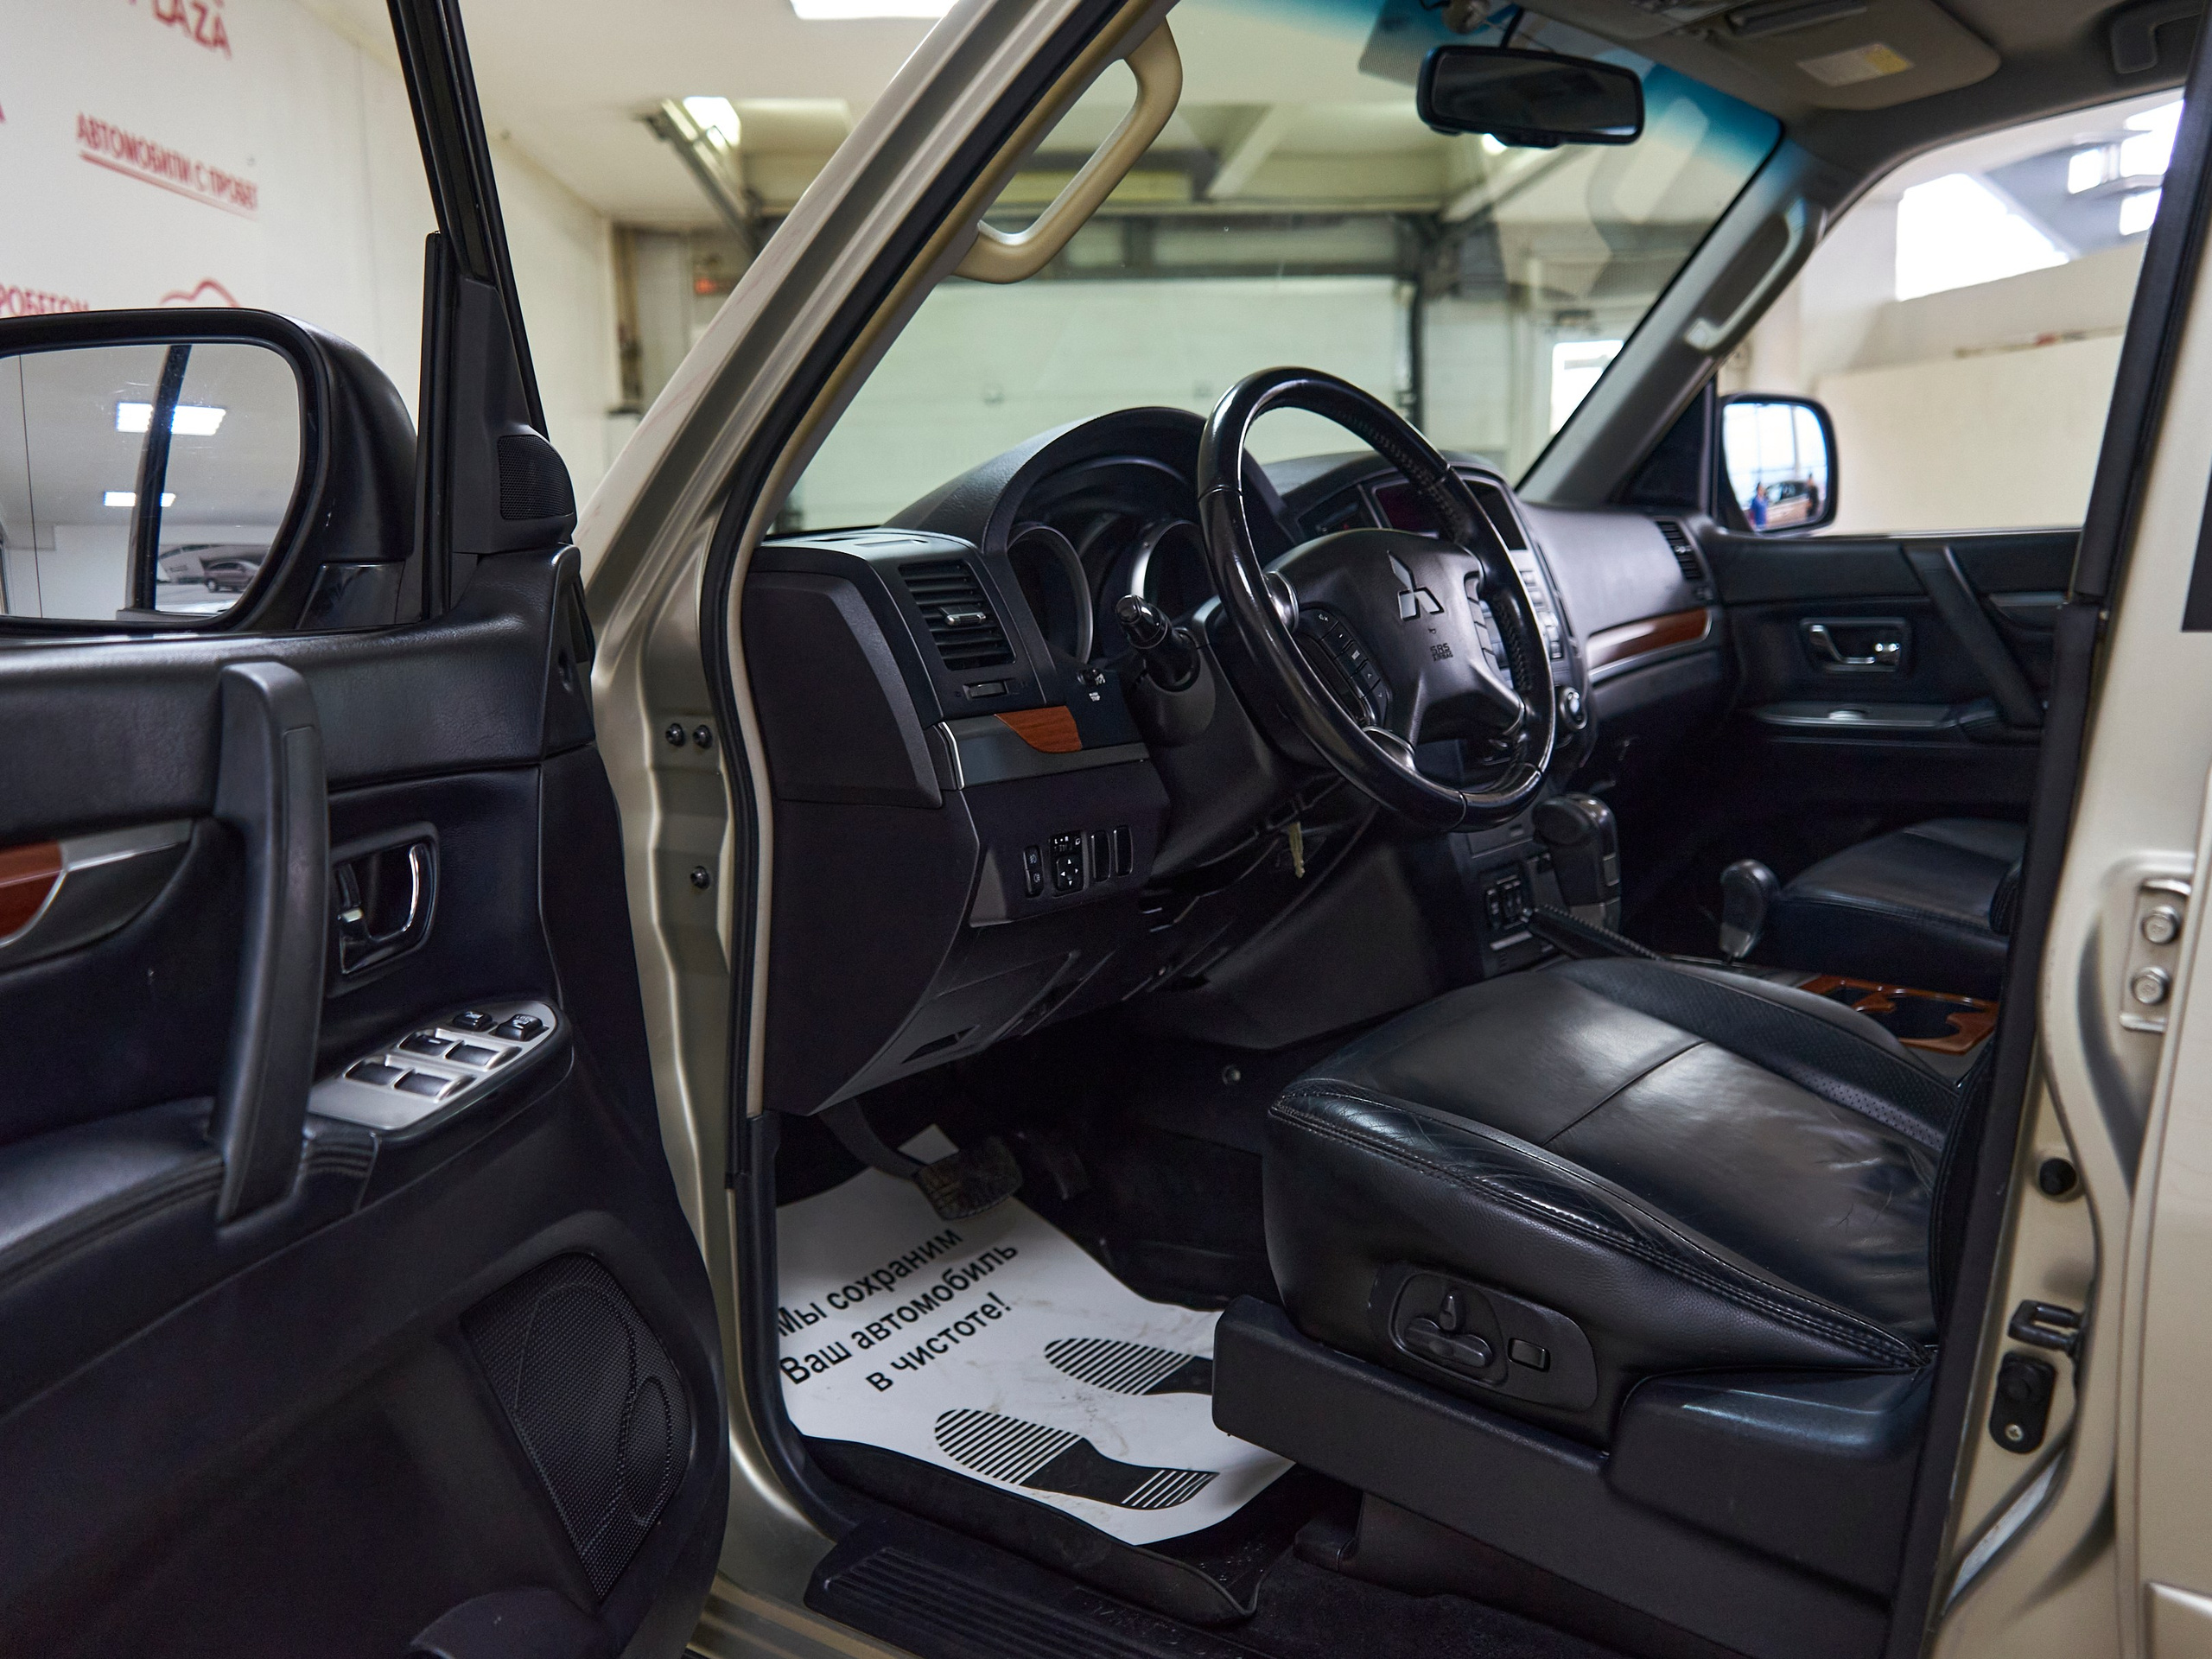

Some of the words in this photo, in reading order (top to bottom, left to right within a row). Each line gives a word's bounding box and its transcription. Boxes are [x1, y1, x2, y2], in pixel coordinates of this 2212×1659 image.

[1430, 642, 1450, 655] SRS
[778, 1302, 828, 1337] Мы
[826, 1228, 963, 1310] сохраним
[779, 1341, 854, 1385] Ваш
[850, 1244, 1019, 1350] автомобиль
[865, 1371, 894, 1393] в
[889, 1291, 1012, 1372] чистоте!
